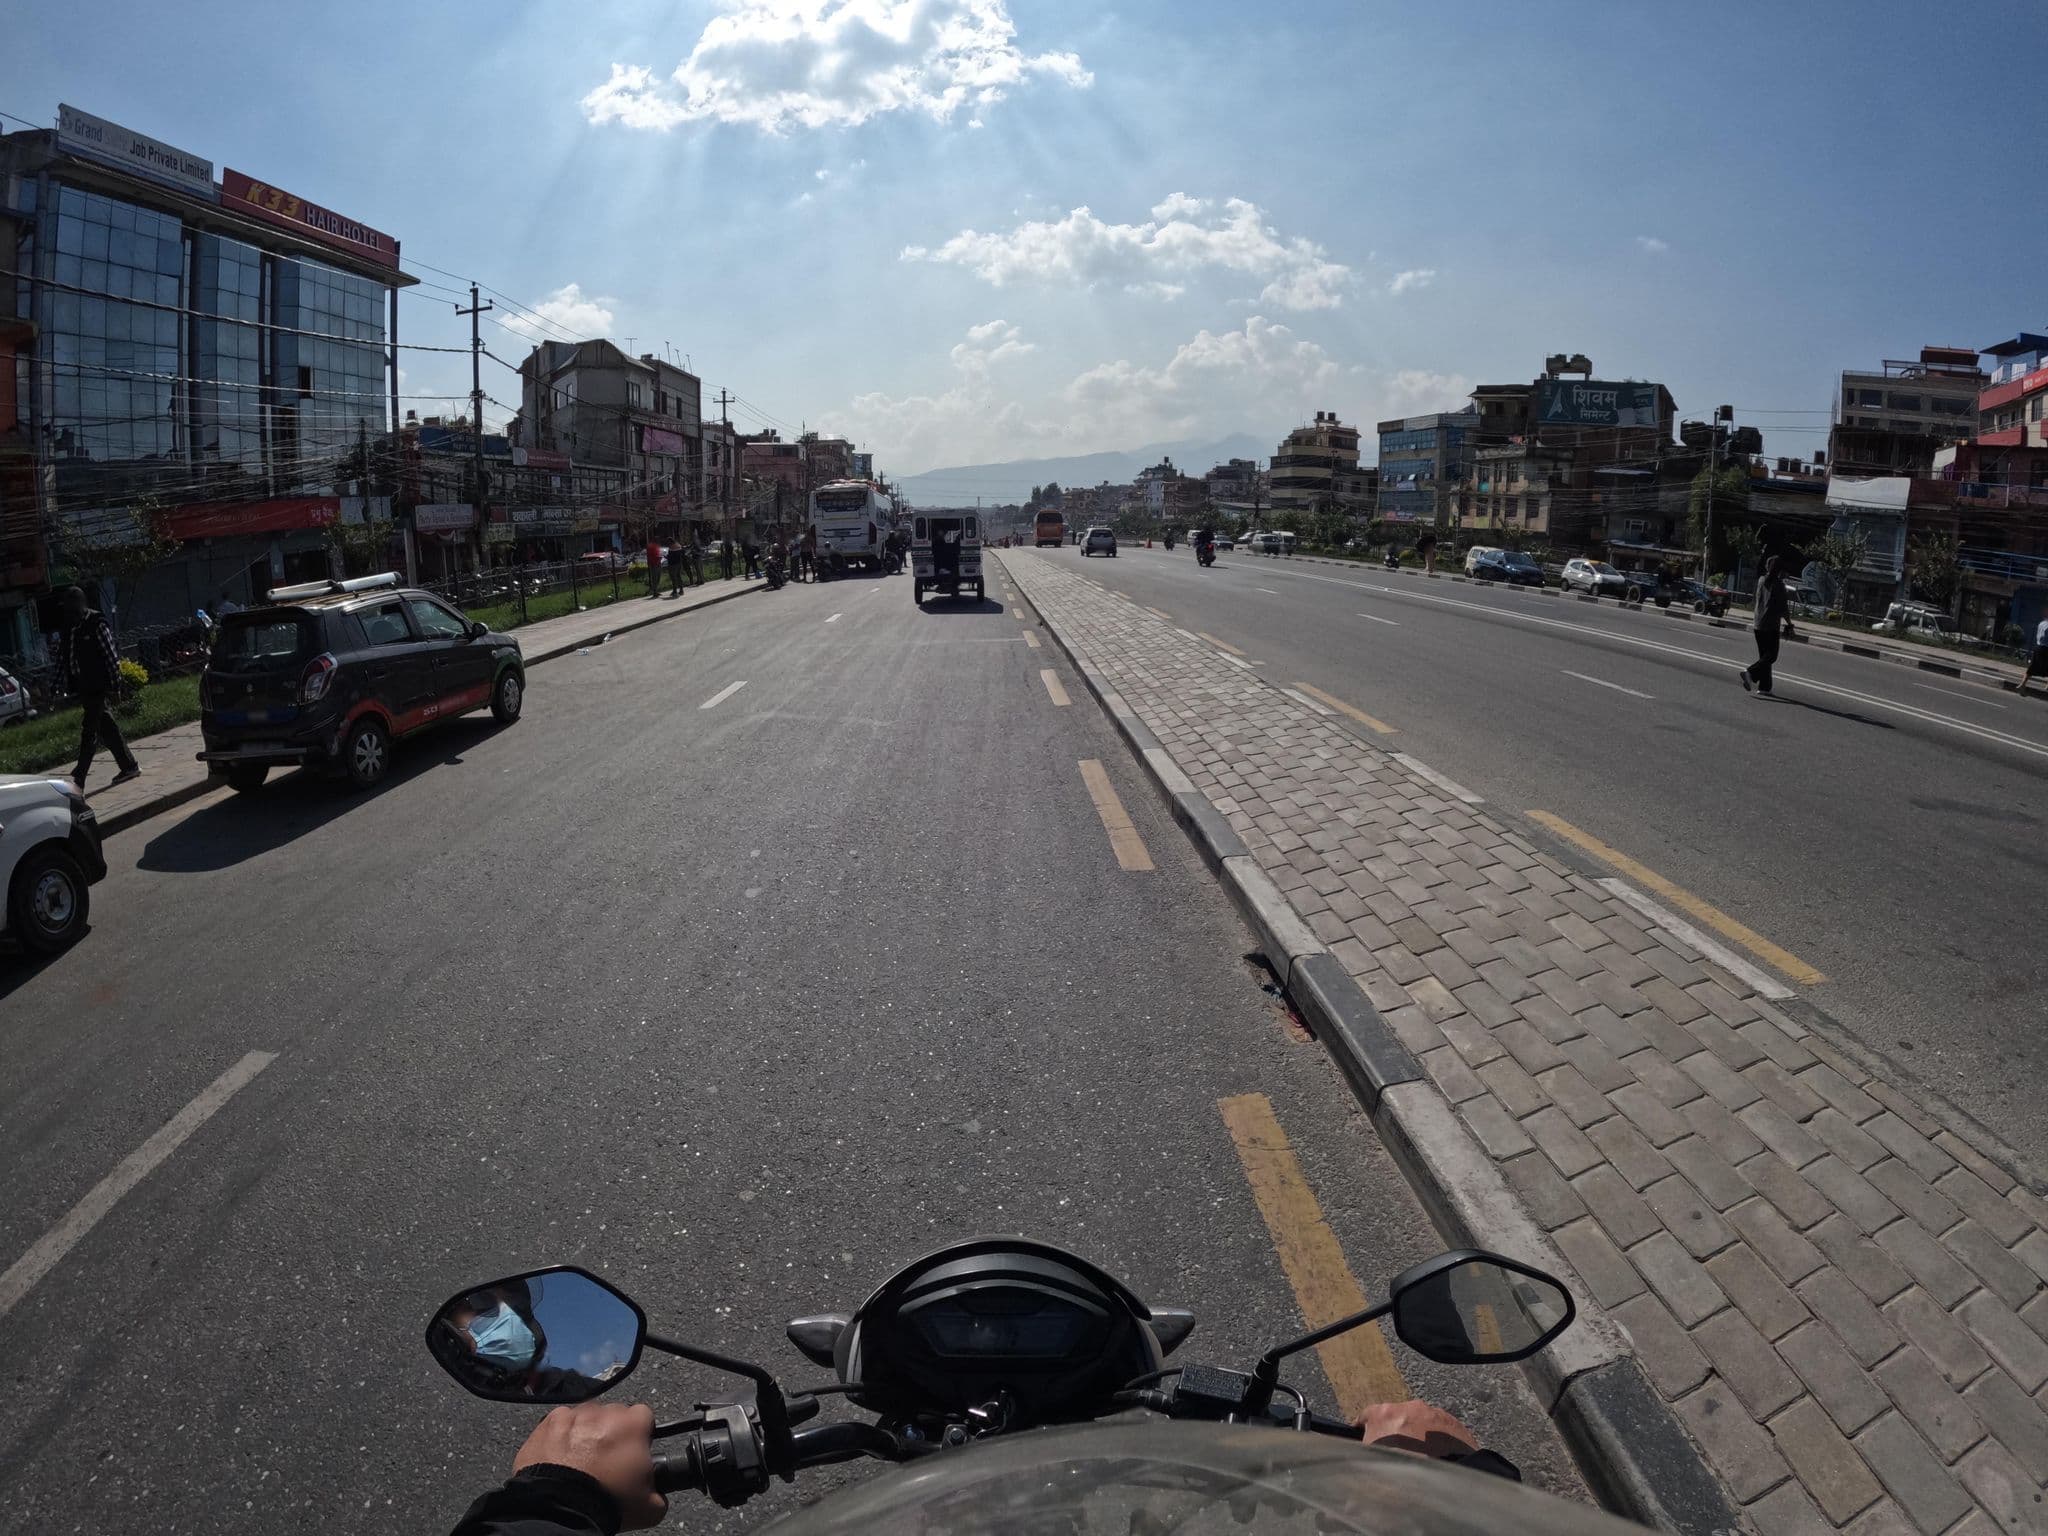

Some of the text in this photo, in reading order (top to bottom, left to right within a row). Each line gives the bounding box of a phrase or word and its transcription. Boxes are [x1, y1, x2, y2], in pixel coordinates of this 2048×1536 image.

[75, 118, 103, 142] Grand
[129, 139, 146, 159] Job
[148, 145, 178, 171] Private
[180, 156, 210, 182] Limited
[306, 206, 340, 233] HAIR
